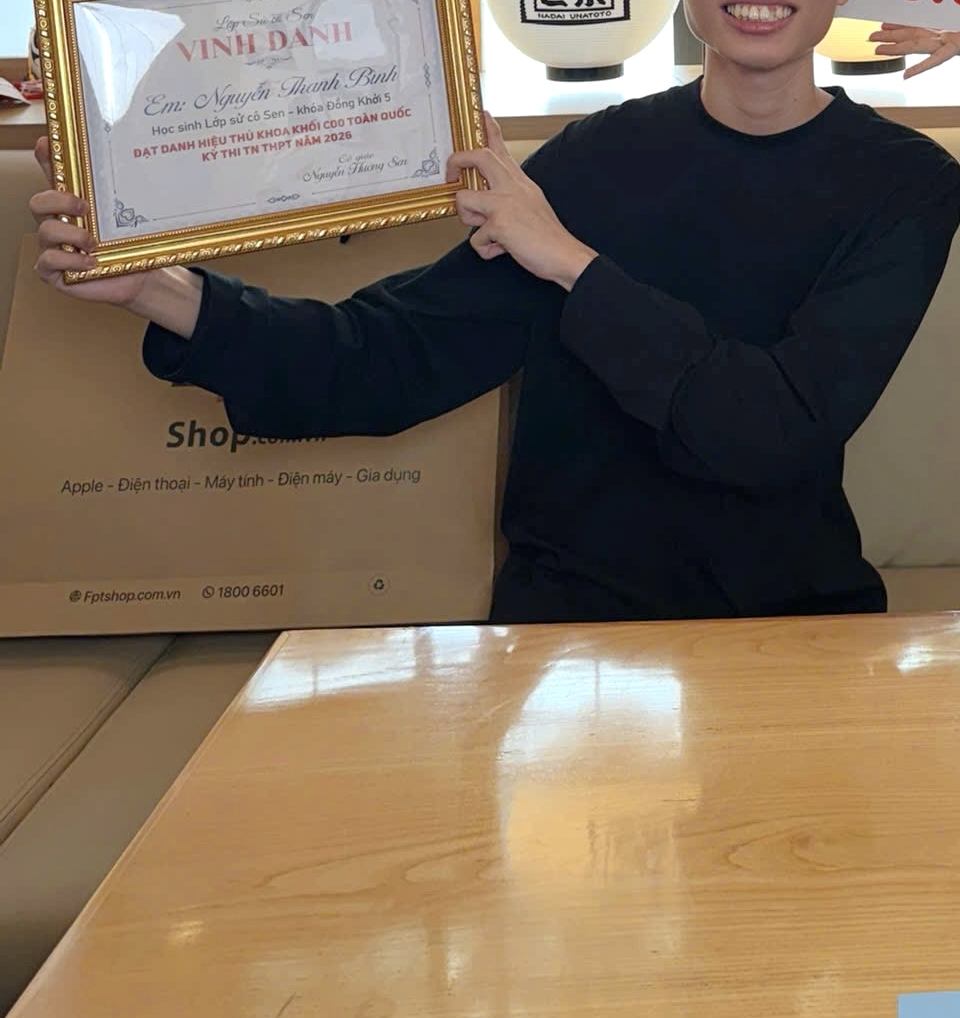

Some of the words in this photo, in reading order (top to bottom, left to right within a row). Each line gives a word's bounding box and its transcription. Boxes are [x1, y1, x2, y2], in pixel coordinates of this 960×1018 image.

[570, 11, 612, 19] UNATOTO
[176, 34, 256, 62] VINH
[269, 22, 352, 51] DANH
[144, 94, 186, 116] Em:
[194, 81, 270, 113] Nguyễn
[278, 73, 340, 98] Thanh
[152, 125, 174, 136] Học
[178, 120, 202, 133] sinh
[205, 116, 227, 129] Lớp
[247, 111, 260, 122] cô
[264, 109, 285, 121] Sen
[297, 104, 324, 116] khóa
[384, 93, 391, 102] 5
[133, 145, 158, 159] ĐẠT
[160, 141, 195, 154] DANH
[198, 135, 227, 149] HIỆU
[229, 129, 254, 144] THỦ
[257, 126, 290, 139] KHOA
[292, 119, 321, 134] KHỐI
[347, 111, 378, 126] TOÀN
[380, 106, 412, 122] QUỐC
[201, 149, 218, 162] KỲ
[221, 149, 240, 159] THI
[243, 145, 259, 156] TN
[262, 140, 292, 152] THPT
[295, 134, 321, 148] NĂM
[324, 131, 352, 143] 2026
[61, 479, 103, 495] Apple
[118, 477, 150, 494] Điện
[155, 476, 190, 493] thoại
[205, 475, 235, 491] Máy
[238, 473, 264, 488] tính
[278, 471, 309, 489] Điện
[313, 470, 343, 486] máy
[356, 468, 380, 483] Gia
[384, 468, 421, 485] dụng
[83, 589, 181, 604] Fptshop.com.vn
[218, 586, 250, 598] 1800
[252, 584, 284, 598] 6601
